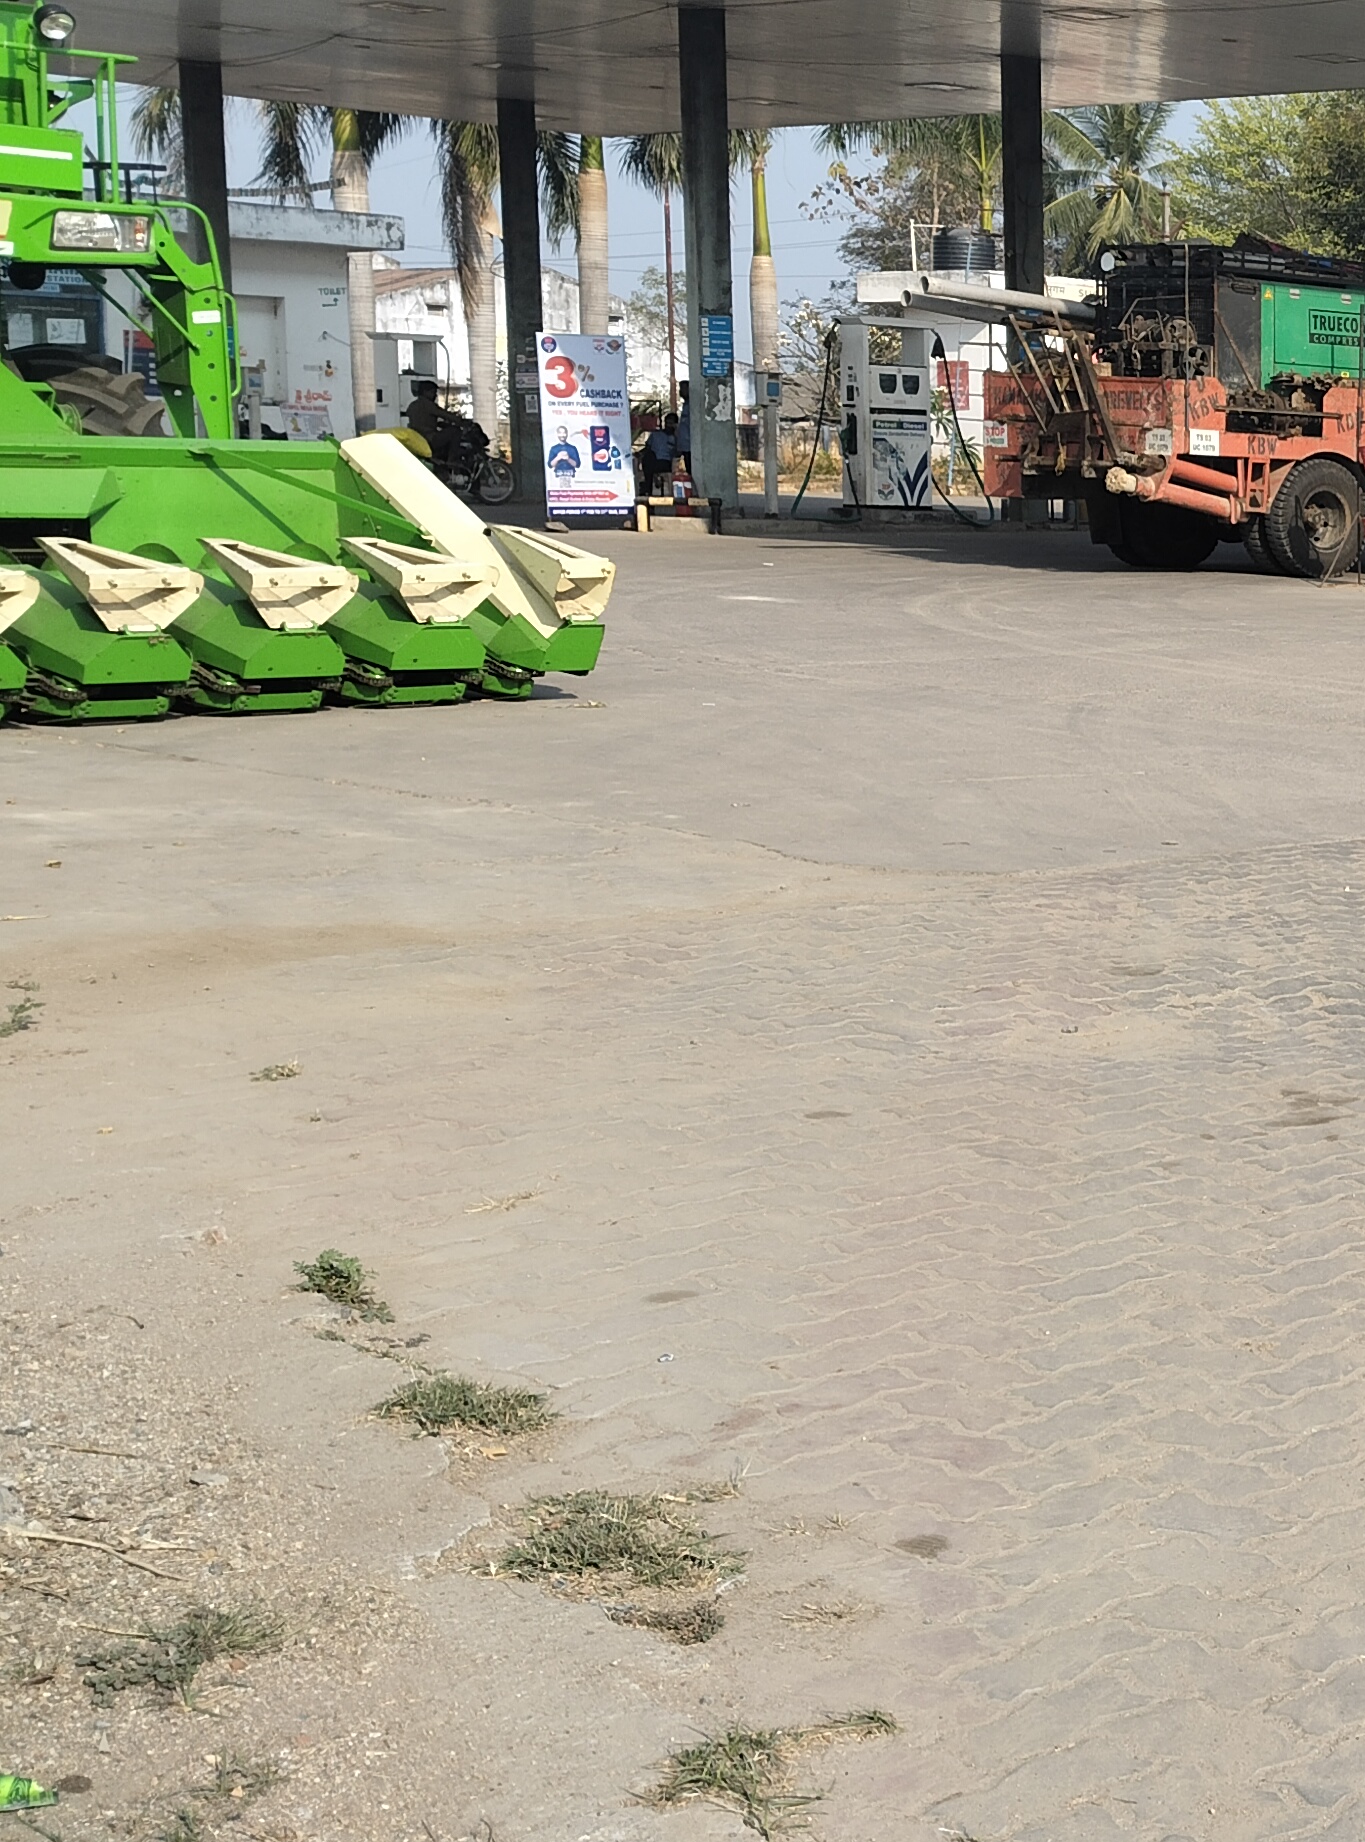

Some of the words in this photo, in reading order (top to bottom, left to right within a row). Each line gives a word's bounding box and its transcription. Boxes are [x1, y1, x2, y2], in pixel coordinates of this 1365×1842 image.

[318, 287, 346, 296] TOILET
[580, 388, 622, 399] CASHBACK
[985, 426, 1005, 437] STOP
[1248, 436, 1277, 456] KBW
